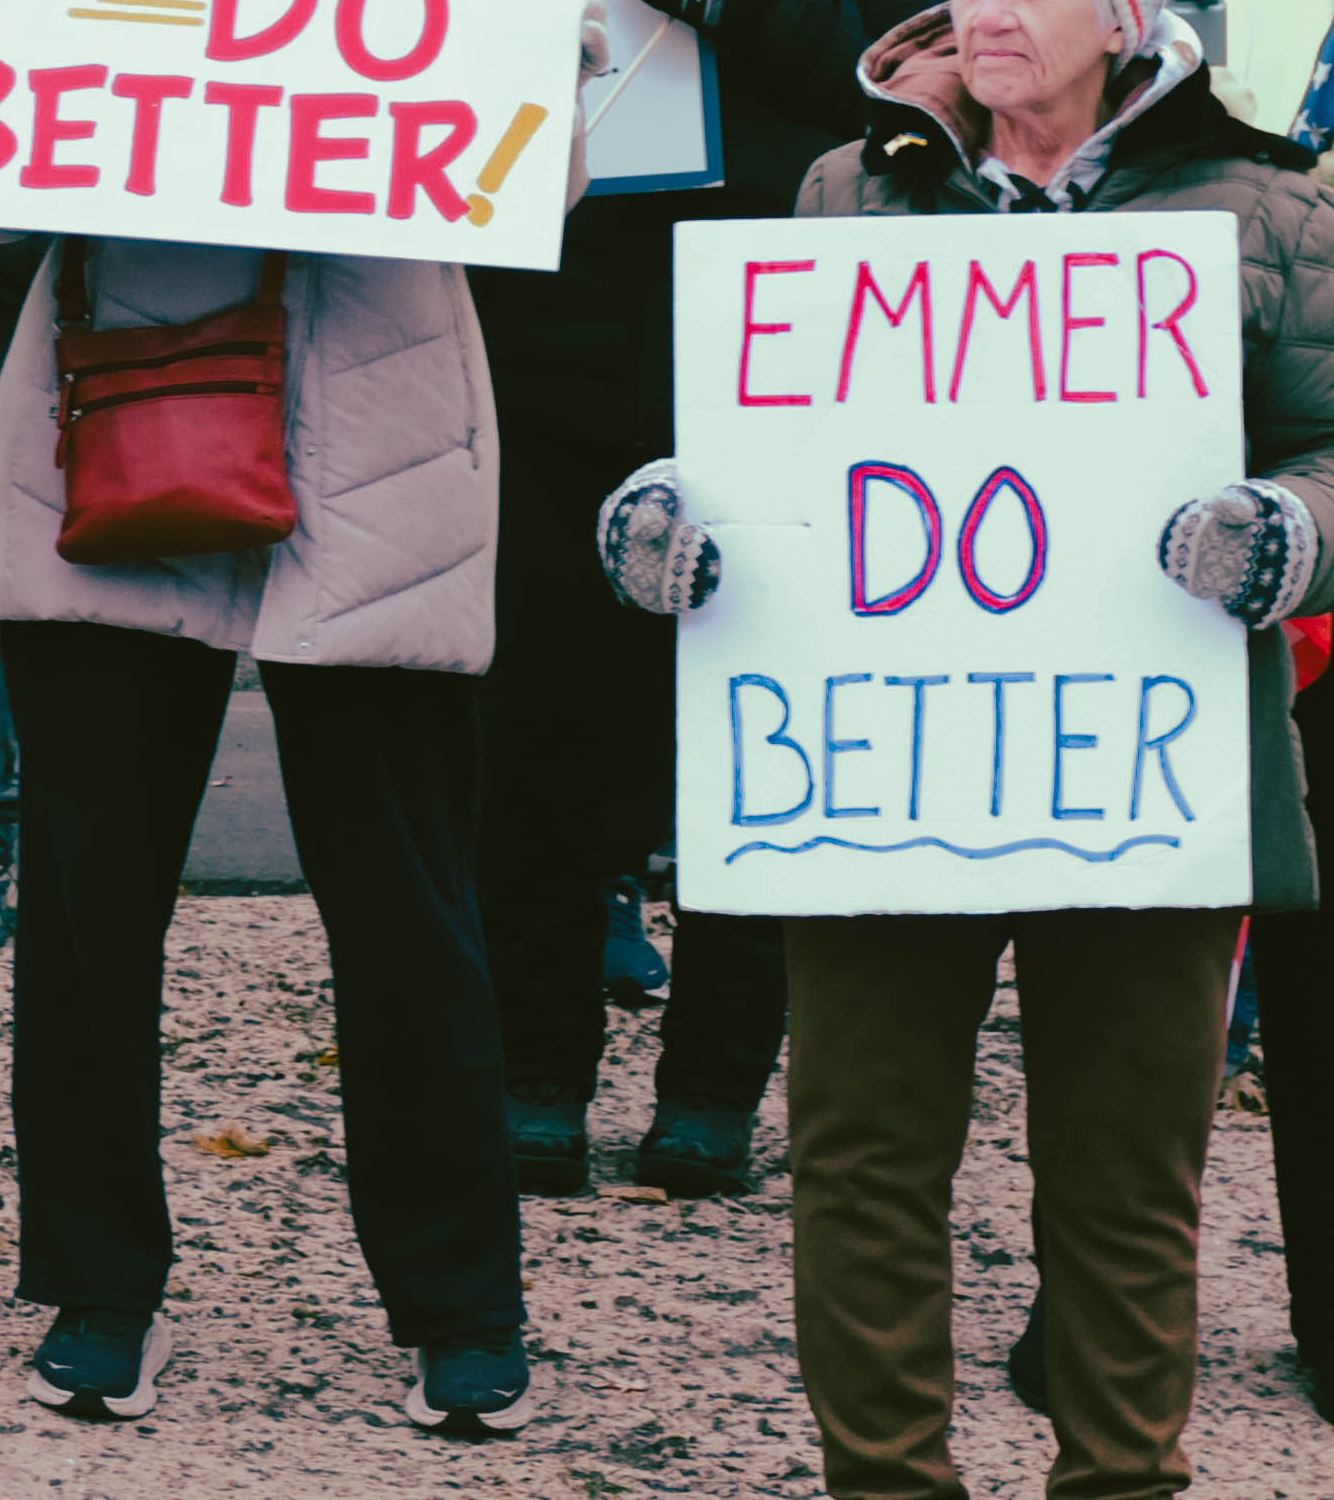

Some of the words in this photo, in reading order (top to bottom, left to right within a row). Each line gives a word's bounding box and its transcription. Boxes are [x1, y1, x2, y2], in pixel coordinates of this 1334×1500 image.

[737, 248, 1210, 408] EMMER
[847, 459, 1048, 618] DO
[727, 672, 1197, 827] BETTER
